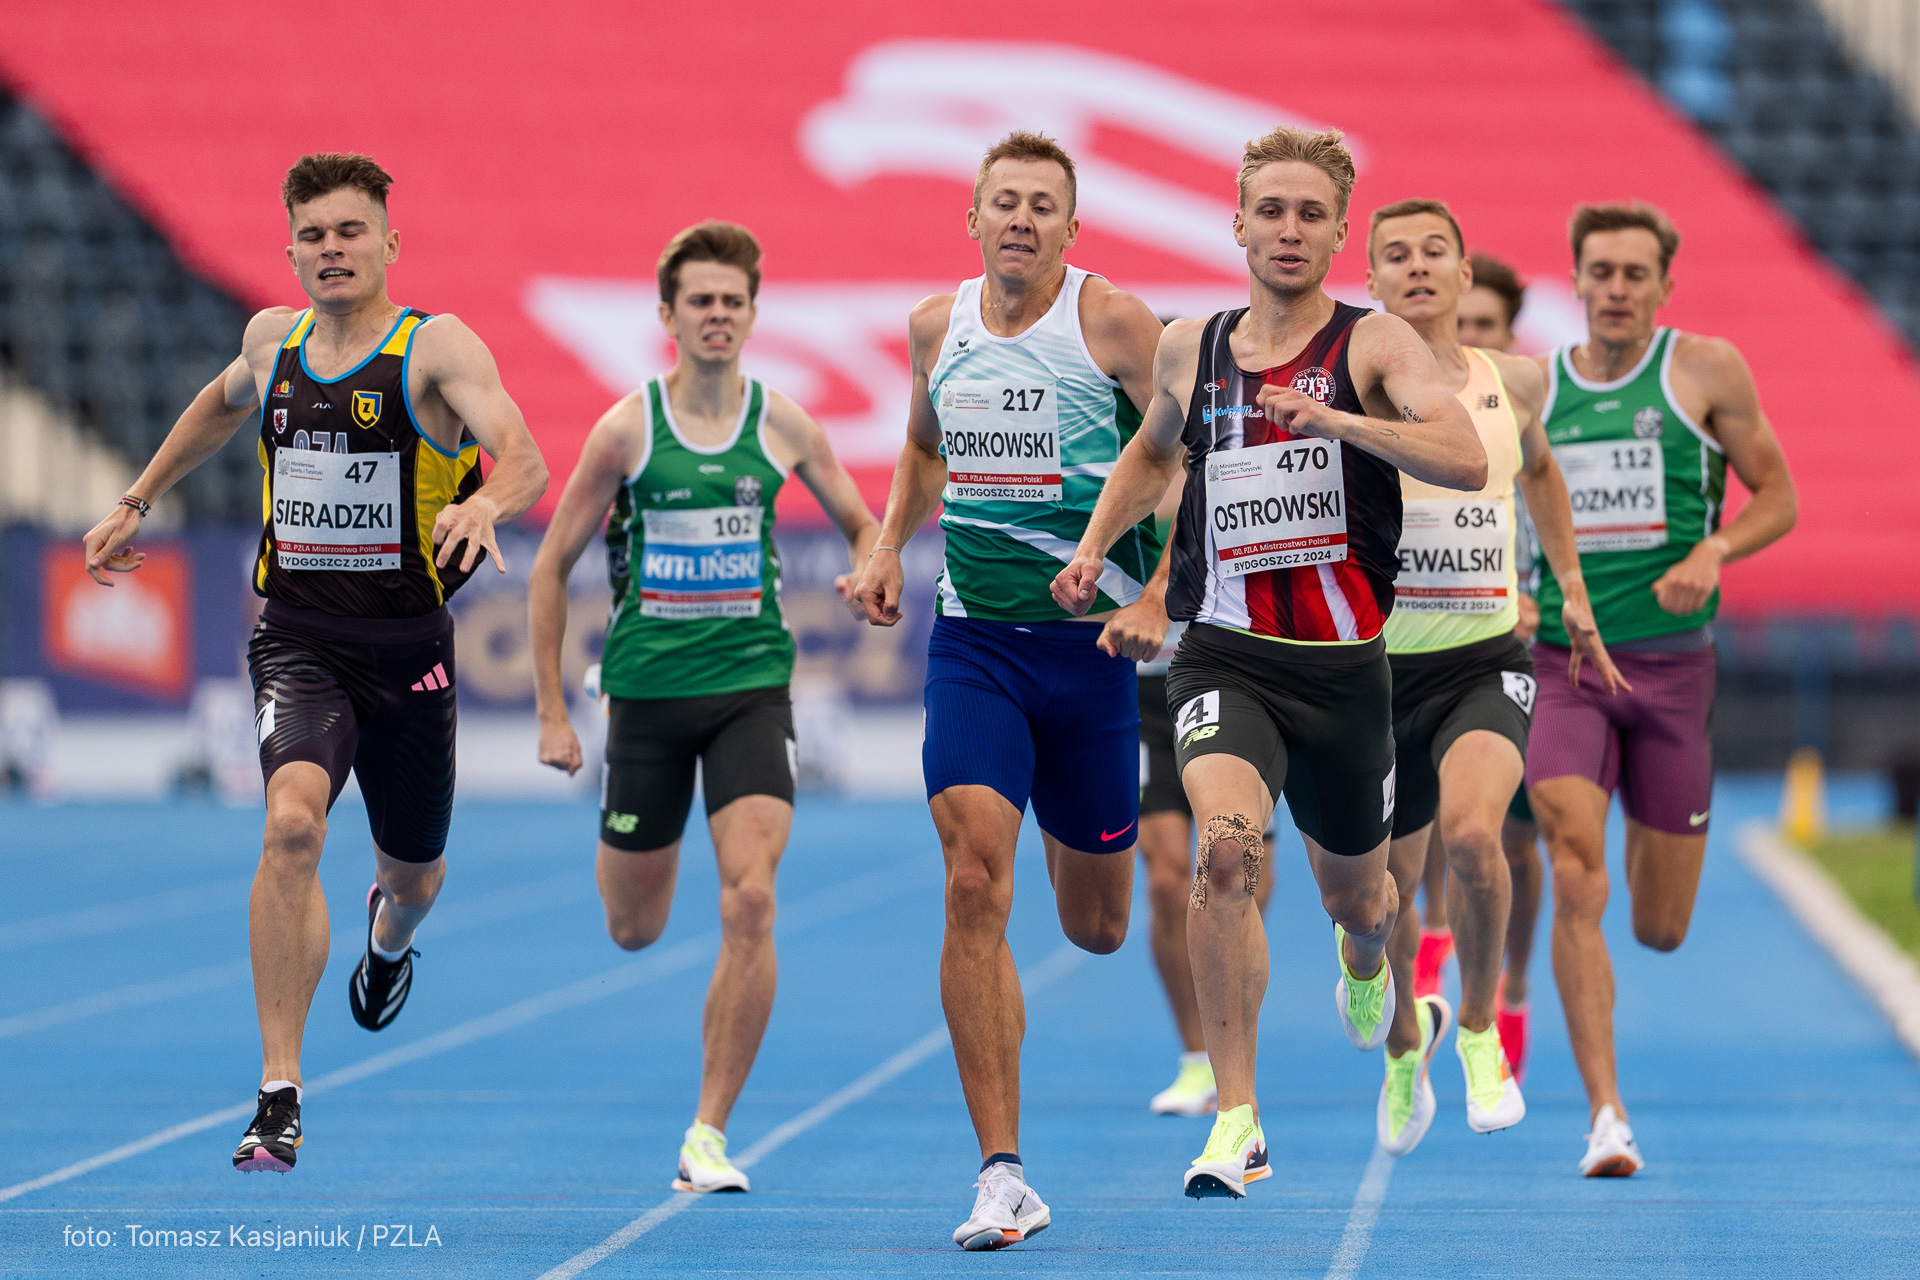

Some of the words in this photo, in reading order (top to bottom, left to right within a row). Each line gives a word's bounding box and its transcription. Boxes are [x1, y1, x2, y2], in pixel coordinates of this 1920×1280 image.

[362, 402, 370, 413] Z
[1002, 388, 1045, 411] 217
[1214, 404, 1252, 417] Kwidzyn
[945, 430, 1054, 458] BORKOWSKI
[290, 461, 315, 469] Ministerstwo
[1219, 461, 1251, 469] Ministerstwo
[1276, 446, 1329, 473] 470
[1612, 447, 1652, 470] 112
[305, 468, 323, 476] Turystyki
[345, 461, 378, 484] 47
[956, 473, 969, 482] 100.
[970, 474, 983, 482] PZLA
[984, 474, 1022, 483] Mistrzostwa
[1023, 475, 1042, 484] Polski
[1220, 469, 1237, 477] Sportu
[1240, 465, 1262, 474] Turystyki
[957, 487, 1016, 498] BYDGOSZCZ
[1018, 489, 1044, 498] 2024
[1571, 485, 1655, 512] OZMYS
[275, 498, 393, 529] SIERADZKI
[1214, 490, 1341, 532] OSTROWSKI
[1455, 507, 1497, 528] 634
[713, 514, 752, 537] 102
[281, 542, 292, 550] 100.
[293, 544, 311, 552] PZLA
[312, 545, 358, 553] Mistrzostwa
[359, 545, 382, 553] Polski
[1232, 548, 1243, 557] 100.
[1244, 545, 1258, 554] PZLA
[1259, 540, 1307, 551] Mistrzostwa
[1308, 537, 1330, 546] Polski
[280, 556, 350, 567] BYDGOSZCZ
[353, 558, 383, 567] 2024
[645, 549, 761, 581] KITLIŃSKI
[1234, 554, 1300, 572] BYDGOSZCZ
[1303, 550, 1332, 563] 2024
[1398, 548, 1503, 573] EWALSKI
[1396, 600, 1467, 610] BYDGOSZCZ
[1470, 601, 1496, 610] 2024
[1183, 696, 1208, 728] 4
